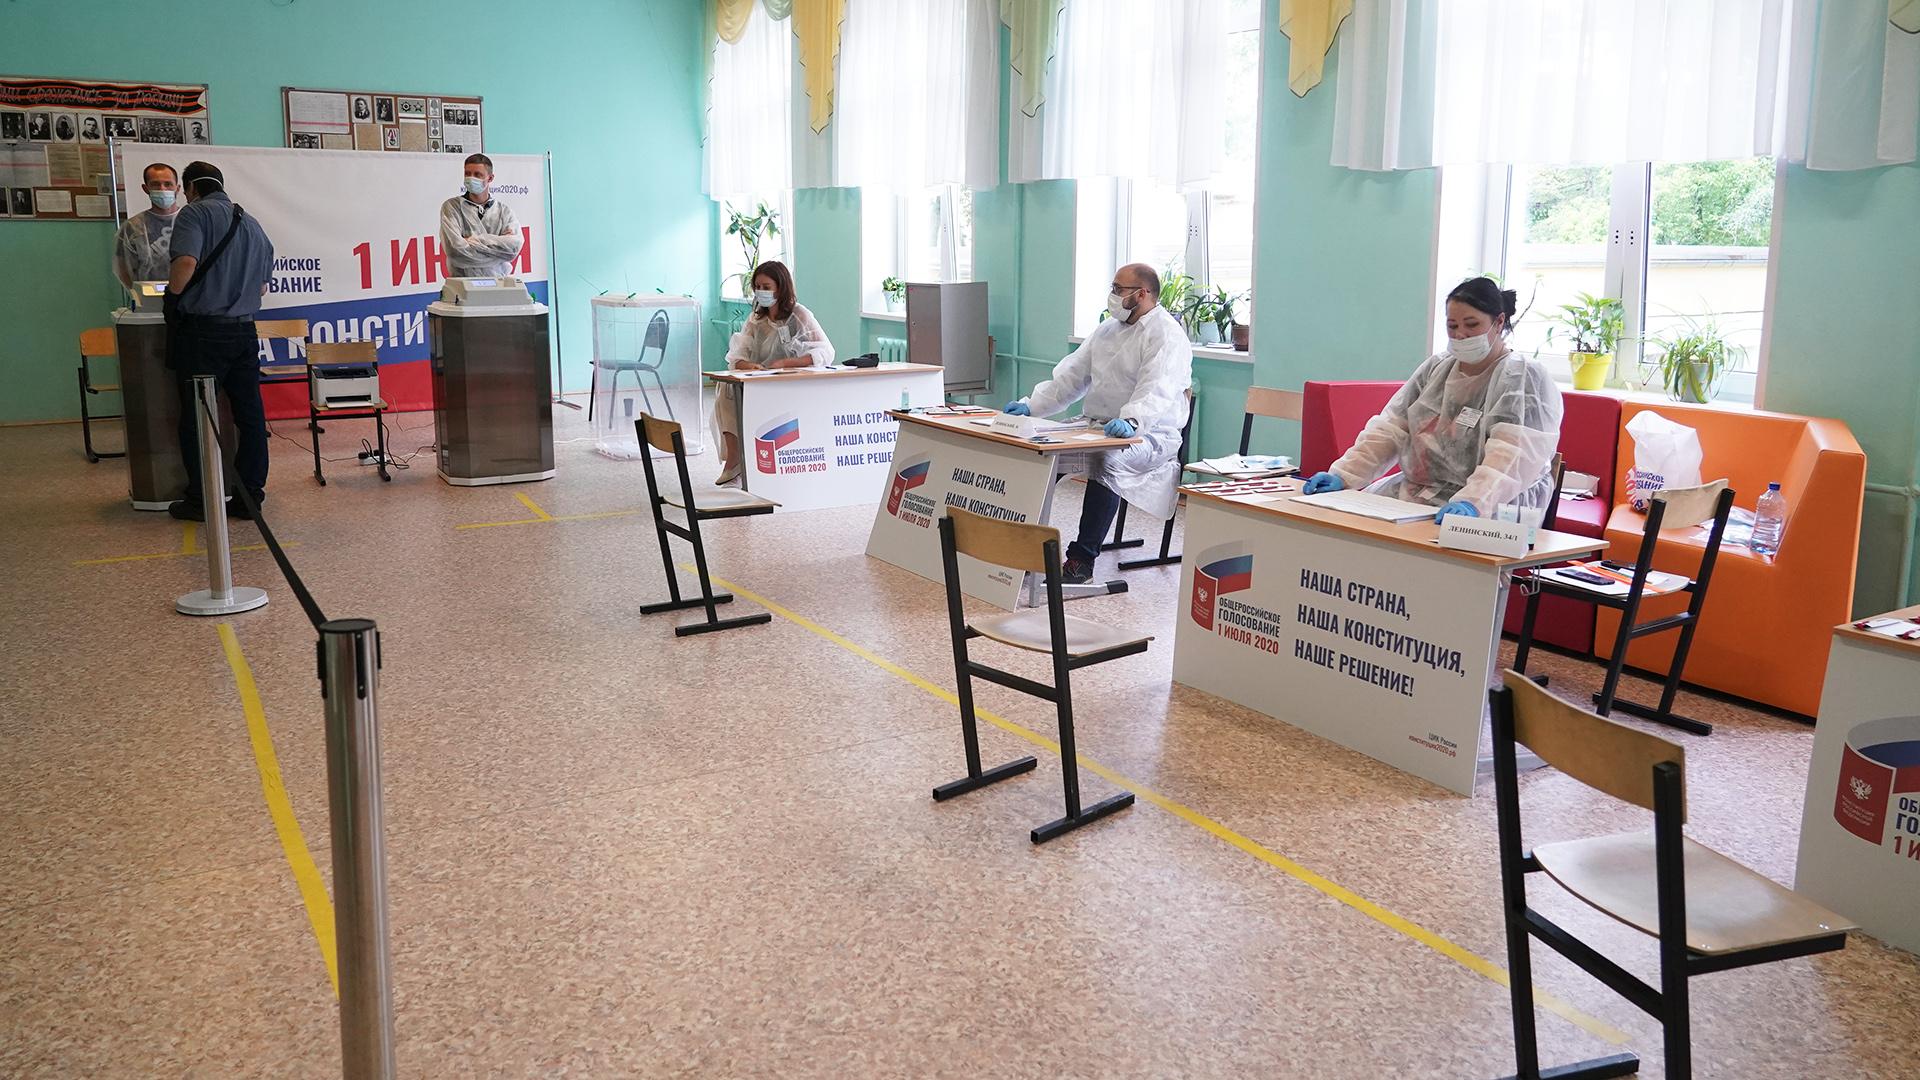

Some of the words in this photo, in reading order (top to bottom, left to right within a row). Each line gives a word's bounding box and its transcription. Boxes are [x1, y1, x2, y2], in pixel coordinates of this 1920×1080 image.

[353, 242, 372, 289] 1
[391, 226, 532, 286] ИЮЯ
[833, 413, 862, 426] НАША
[835, 433, 864, 446] НАША
[867, 431, 897, 444] КОНСТ
[778, 446, 824, 456] ОБЩЕРОССИЙСКОЕ
[779, 454, 825, 464] ГОЛОСОВАНИЕ
[837, 453, 864, 466] НАШЕ
[785, 464, 806, 474] ИЮЛЯ
[808, 463, 826, 473] 2020
[952, 467, 974, 486] НАША
[975, 474, 1006, 496] СТРАНА,
[945, 492, 967, 509] НАША
[917, 516, 931, 529] 2020
[1300, 568, 1342, 598] НАША
[1347, 582, 1410, 621] СТРАНА,
[1219, 597, 1280, 624] ОБЩЕРОССИЙСКОЕ
[1218, 608, 1280, 638] ГОЛОСОВАНИЕ
[1217, 623, 1222, 636] 1
[1224, 624, 1251, 646] ИЮЛЯ
[1254, 635, 1279, 655] 2020
[1297, 604, 1339, 634] НАША
[1344, 618, 1465, 677] КОНСТИТУЦИЯ,
[1295, 639, 1336, 669] НАШЕ
[1339, 653, 1415, 697] РЕШЕНИЕ!
[1895, 835, 1902, 854] 1
